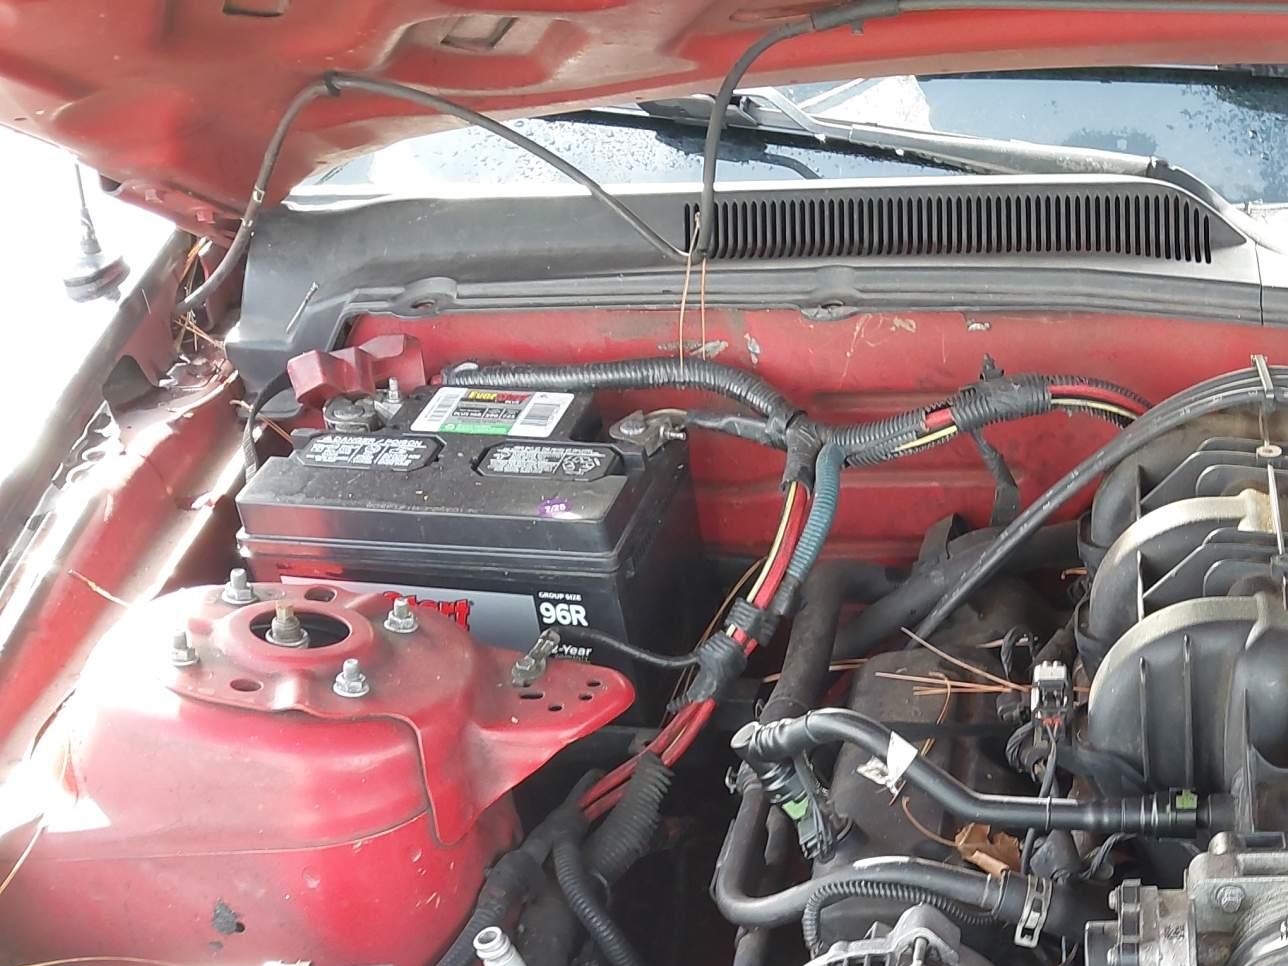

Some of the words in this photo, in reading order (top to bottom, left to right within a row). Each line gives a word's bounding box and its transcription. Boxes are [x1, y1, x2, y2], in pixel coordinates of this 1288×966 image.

[538, 592, 565, 600] GROUP
[565, 593, 582, 602] SIZE
[540, 602, 589, 627] 96R
